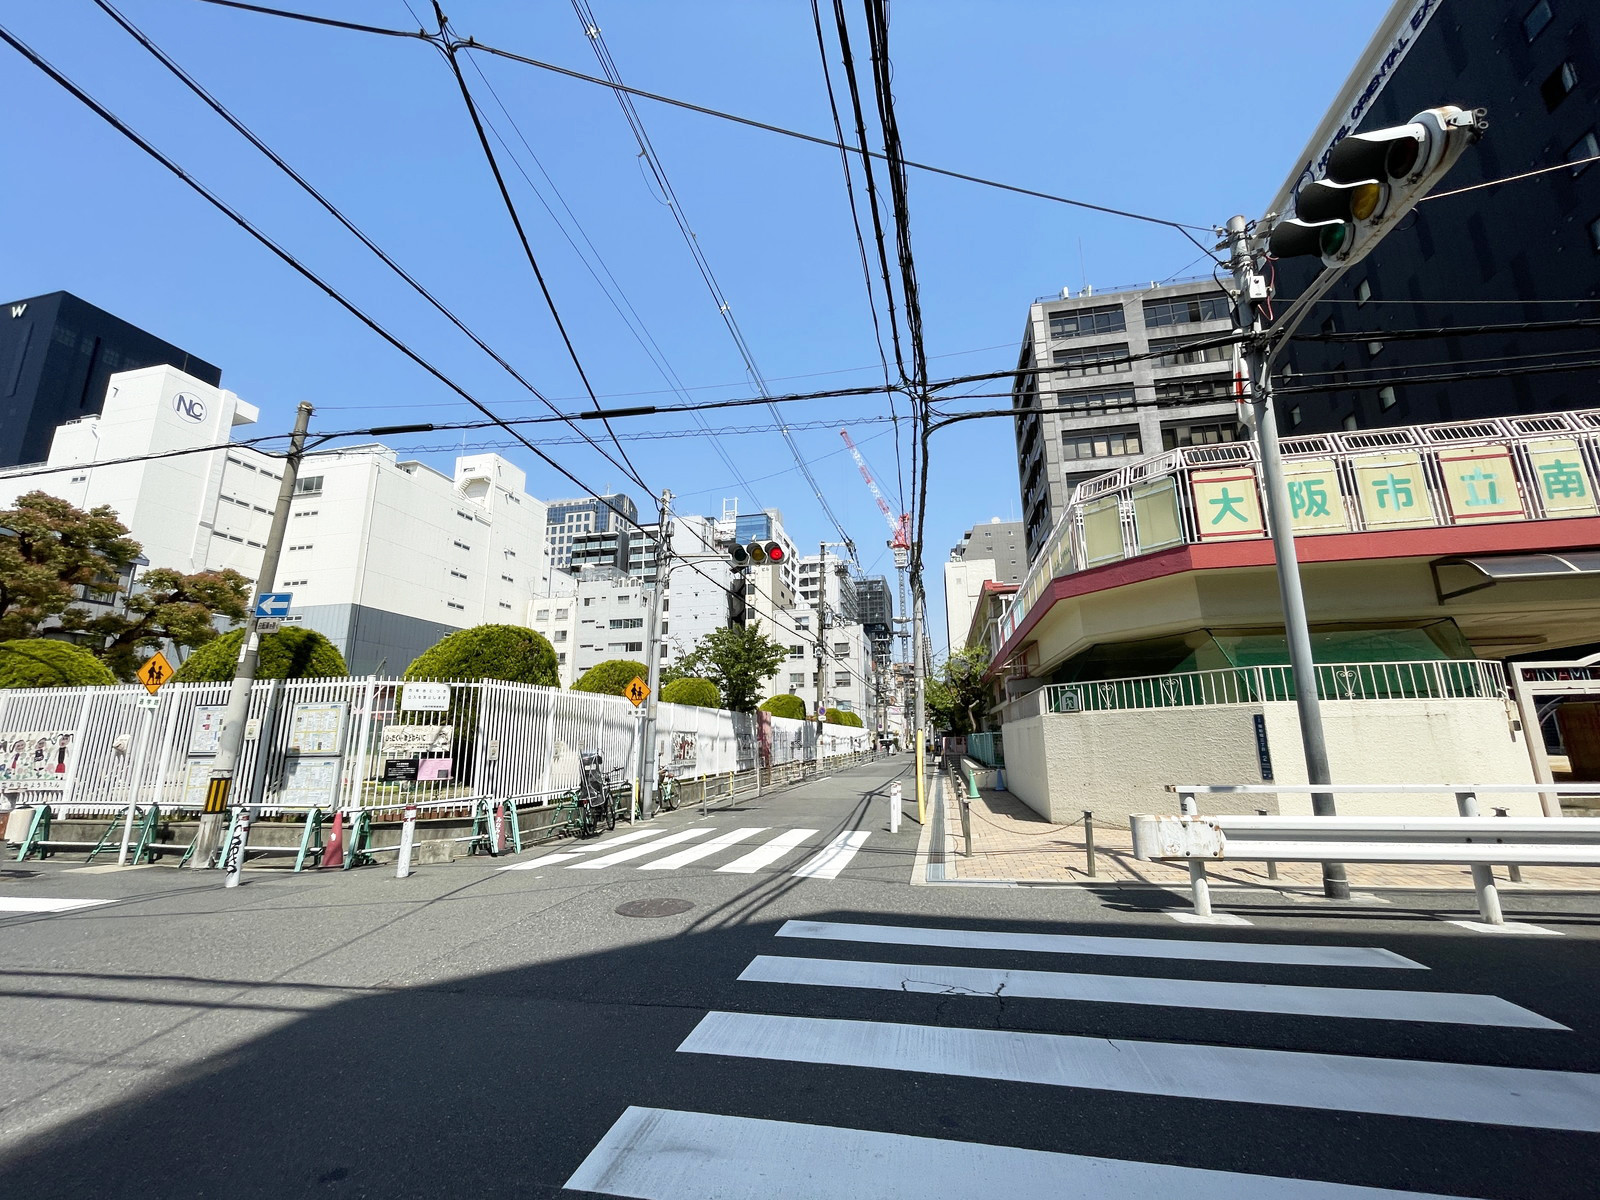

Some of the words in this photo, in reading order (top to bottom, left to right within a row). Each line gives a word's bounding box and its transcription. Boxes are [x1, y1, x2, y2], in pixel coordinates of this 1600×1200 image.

[1350, 38, 1410, 120] ORIENTAL
[1410, 0, 1437, 32] EX
[11, 303, 28, 319] W
